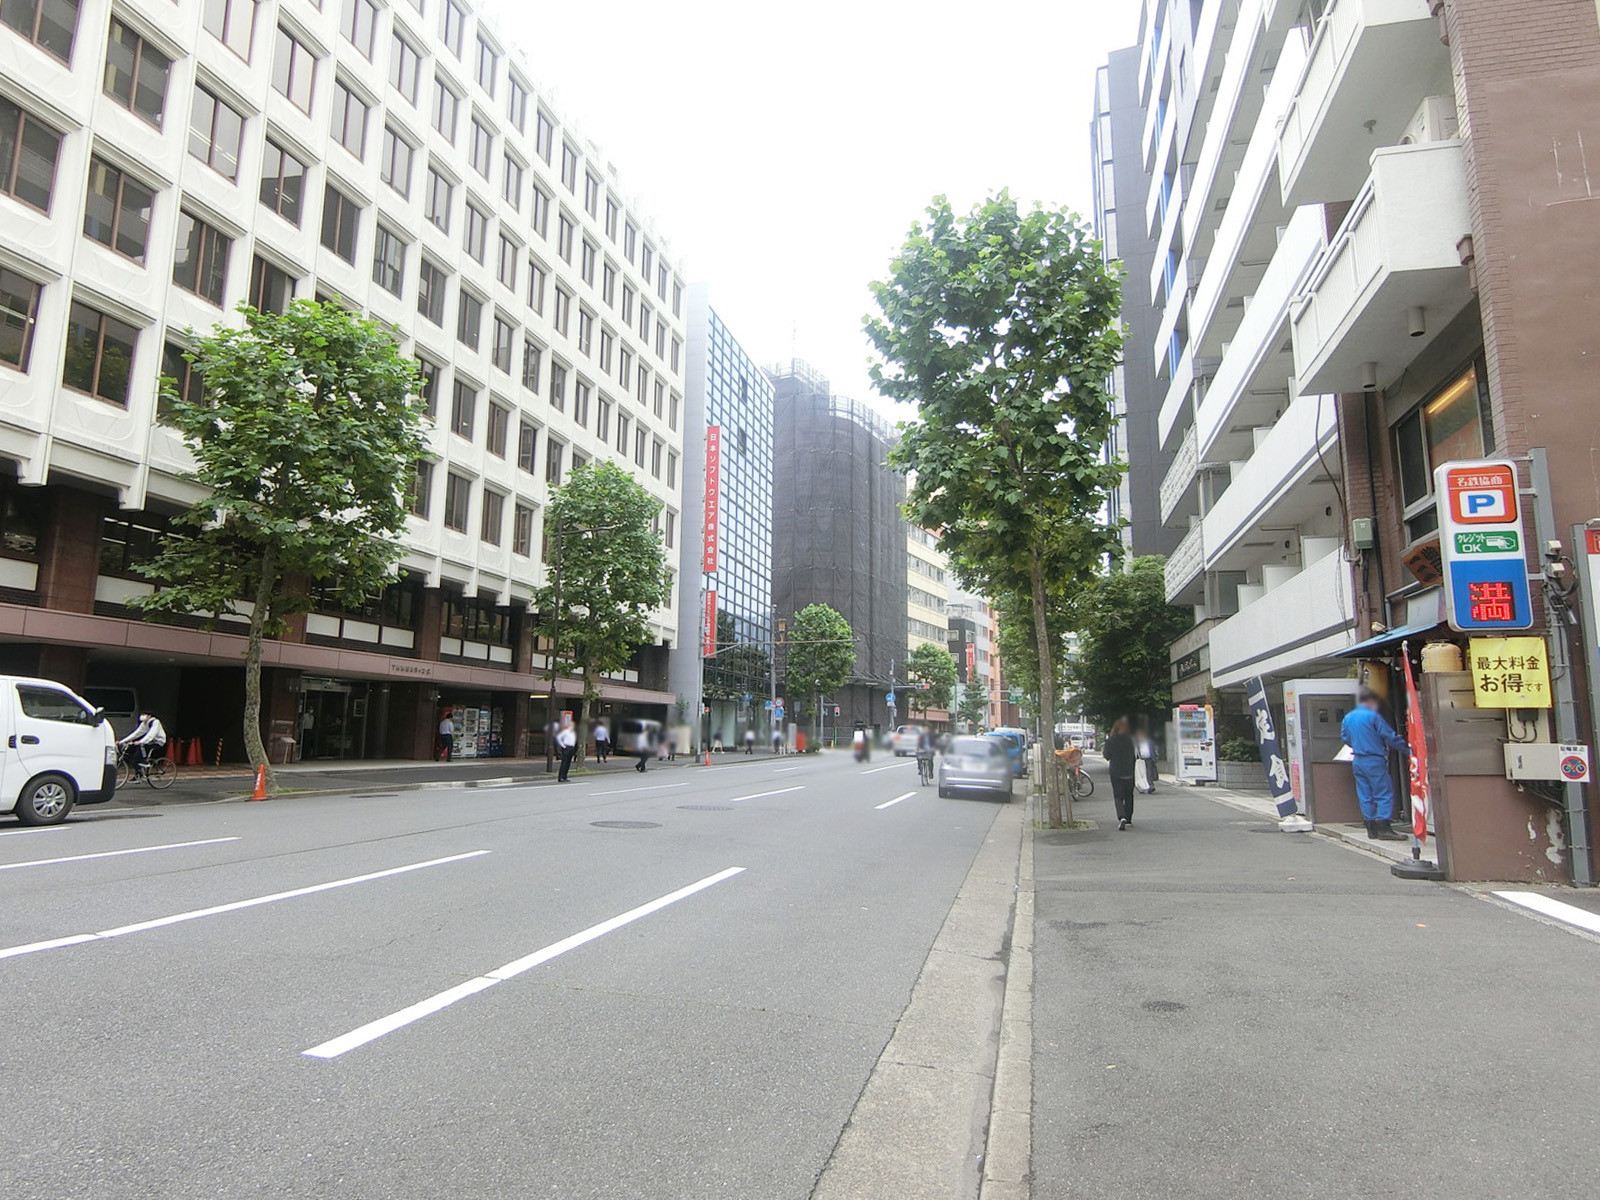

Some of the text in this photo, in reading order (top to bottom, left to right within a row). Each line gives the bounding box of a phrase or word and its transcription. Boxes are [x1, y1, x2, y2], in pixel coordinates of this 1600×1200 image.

[1467, 494, 1496, 514] P
[1457, 533, 1487, 543] クレジット
[1462, 543, 1482, 552] OK
[1477, 656, 1540, 671] 最大料金
[1480, 673, 1543, 694] お得です
